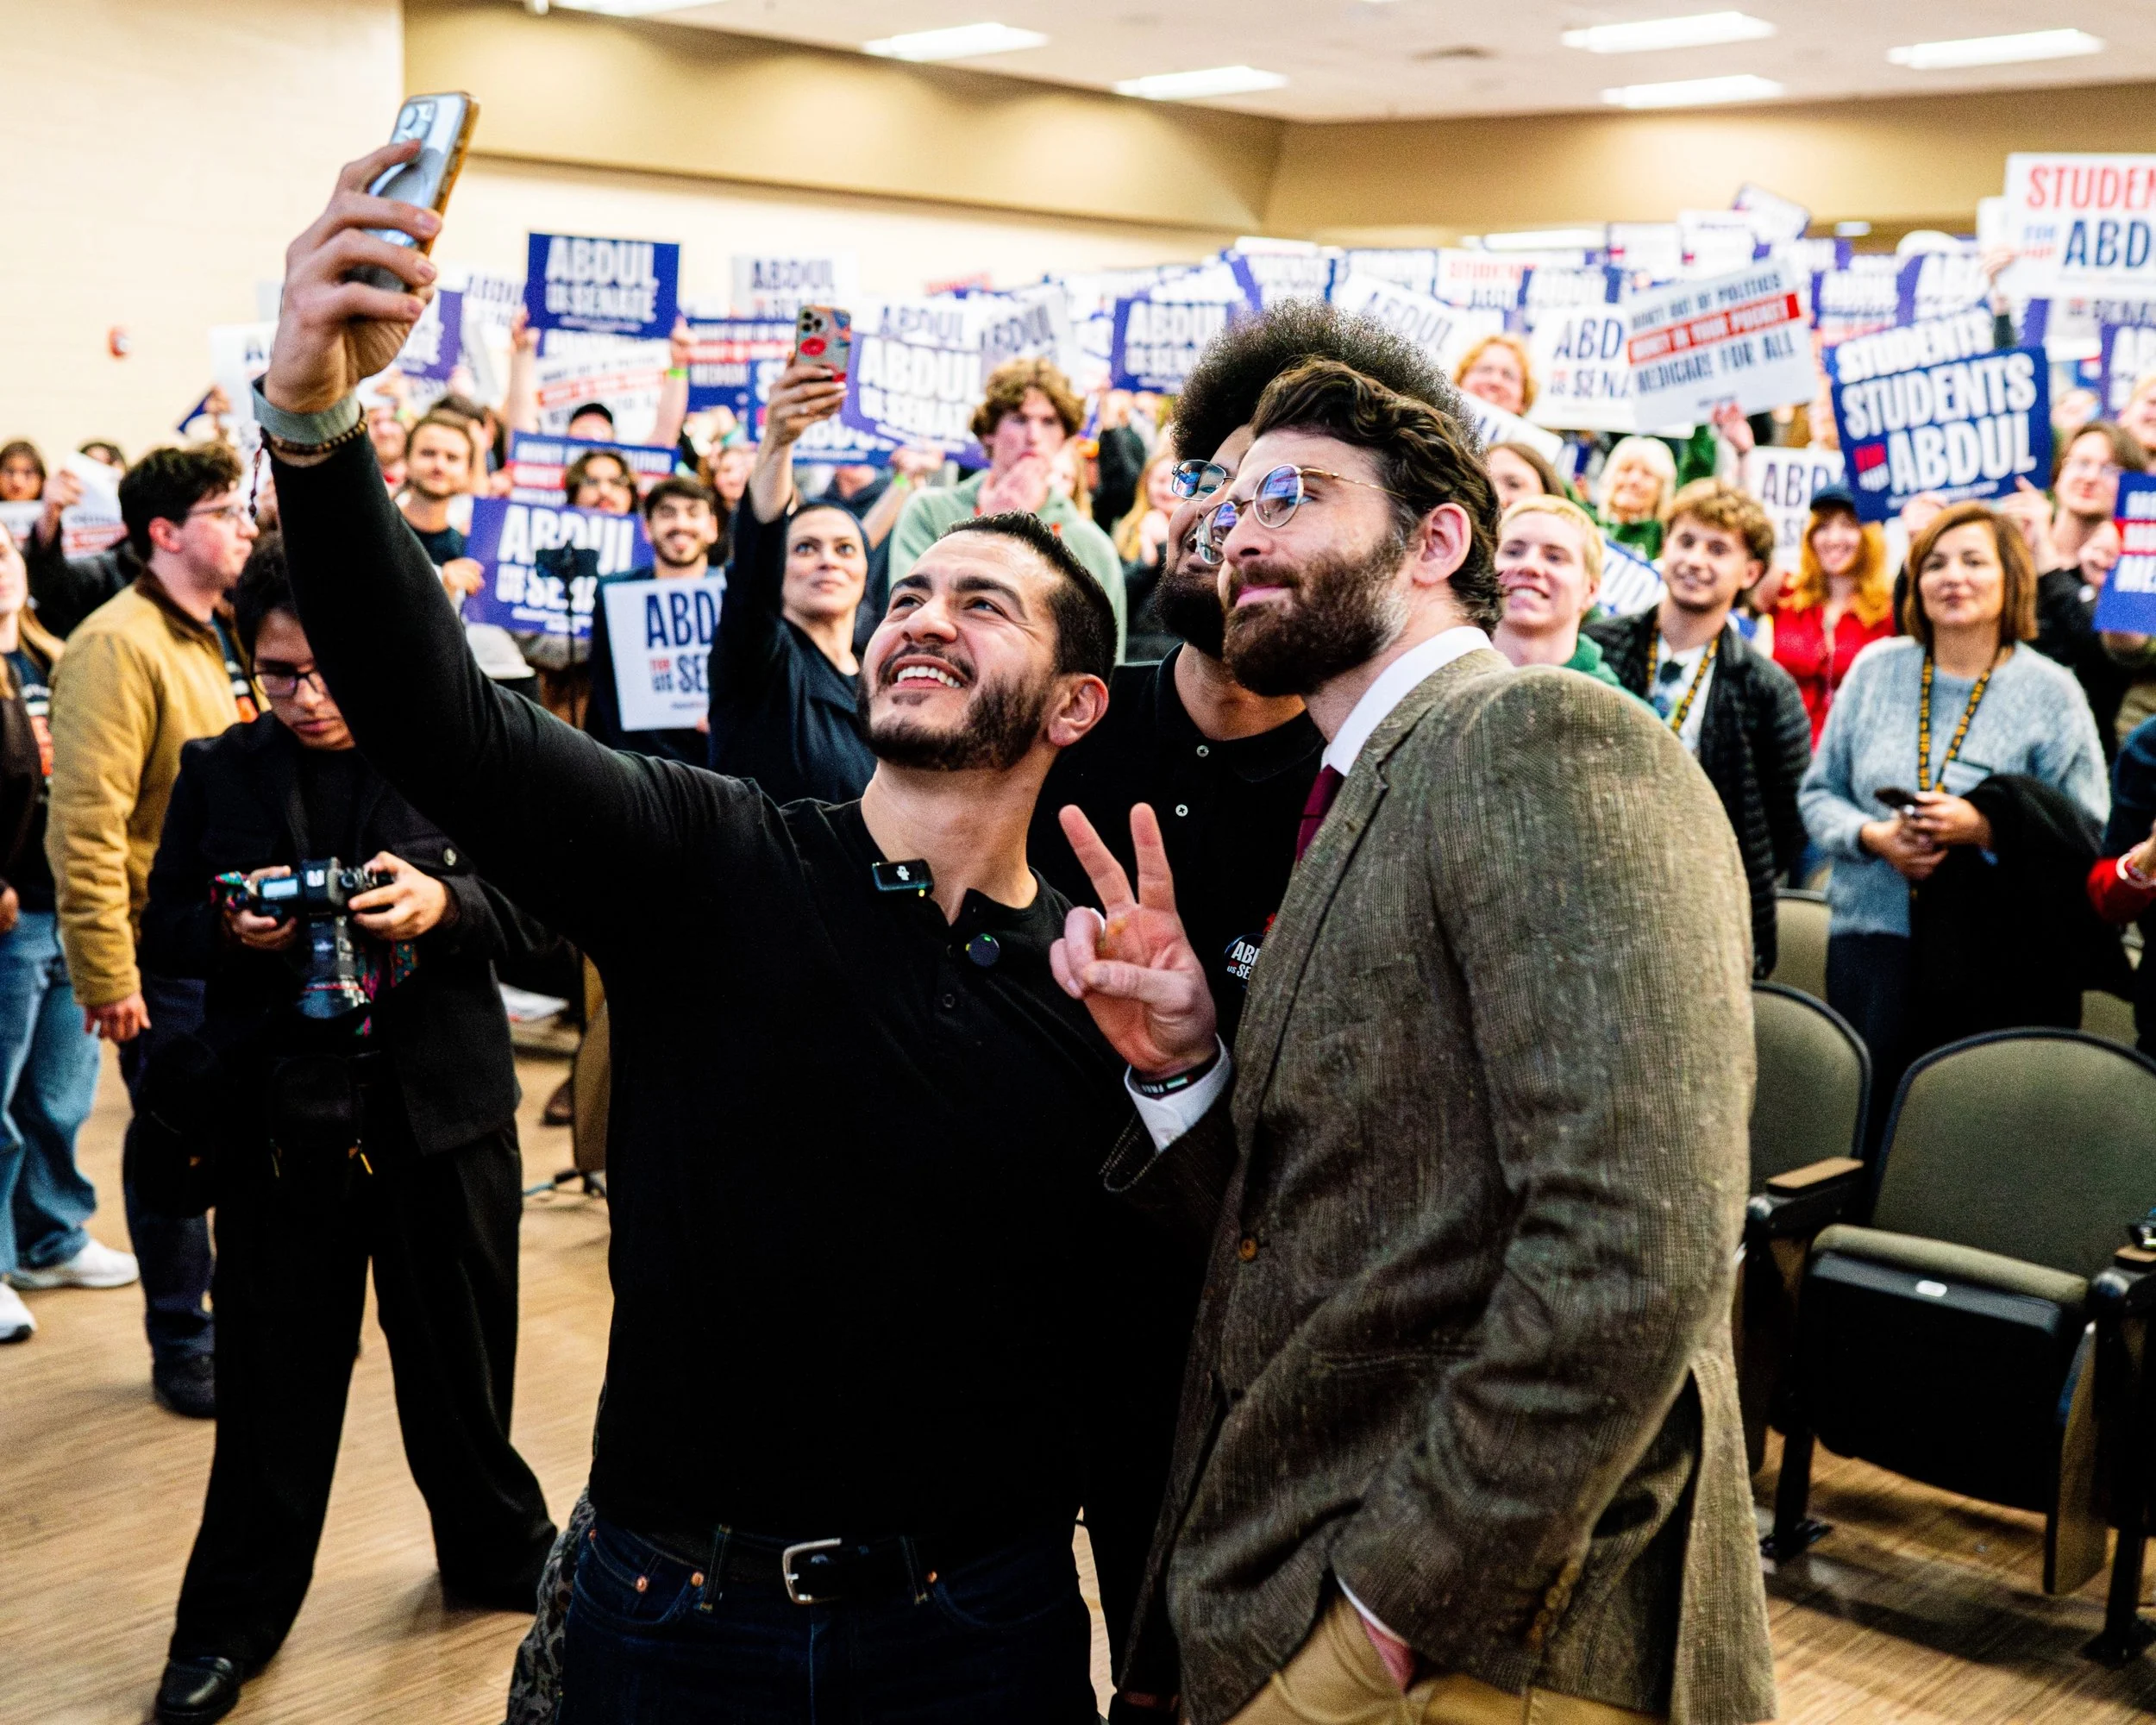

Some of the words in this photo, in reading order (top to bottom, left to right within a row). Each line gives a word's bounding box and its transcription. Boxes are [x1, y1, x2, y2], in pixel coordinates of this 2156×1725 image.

[545, 235, 660, 289] ABDUL
[2064, 219, 2151, 267] ABD
[1717, 270, 1783, 303] POLITICS
[1553, 317, 1623, 360] ABD
[1761, 329, 1797, 361] ALL
[1836, 307, 1994, 385] STUDENTS
[857, 336, 986, 404] ABDUL
[1842, 352, 2037, 441] STUDENTS
[1888, 412, 2037, 496] ABDUL
[644, 588, 727, 649] ABD
[1226, 965, 1238, 974] US
